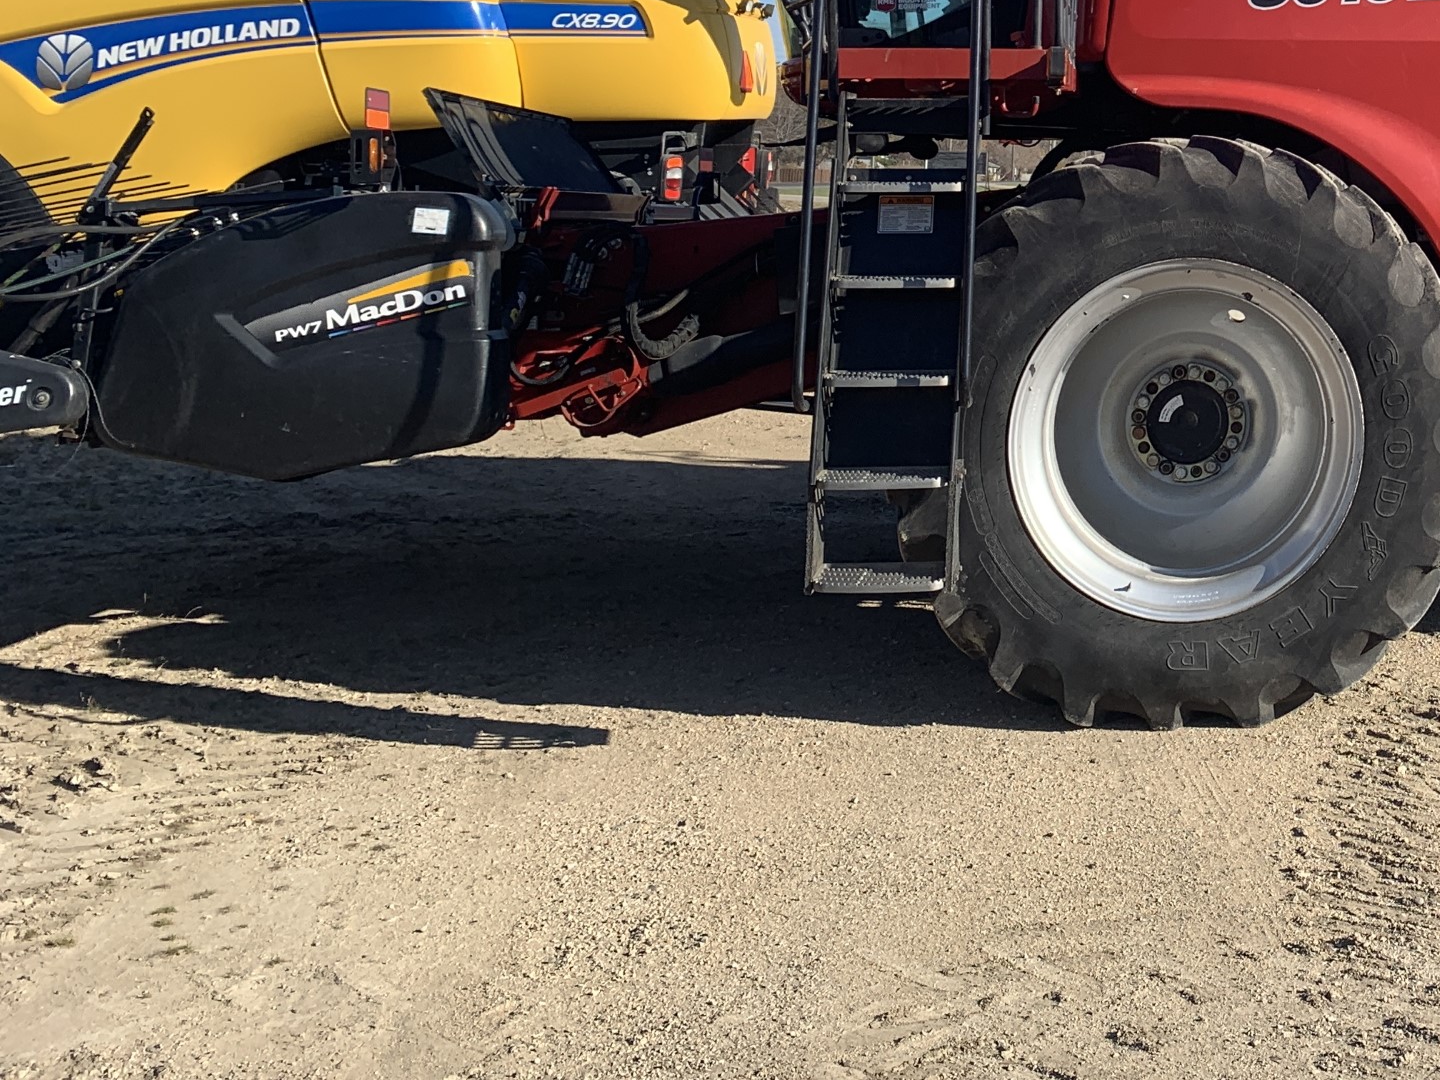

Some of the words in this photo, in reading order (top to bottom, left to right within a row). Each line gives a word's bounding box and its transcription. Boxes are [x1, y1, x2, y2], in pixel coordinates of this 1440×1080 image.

[551, 13, 637, 29] CX8.90
[898, 2, 941, 10] EQUIPMENT
[97, 34, 165, 69] NEW
[168, 17, 301, 52] HOLLAND
[274, 320, 323, 343] PW7
[325, 283, 466, 330] MacDon
[1164, 333, 1414, 672] GOODYEAR
